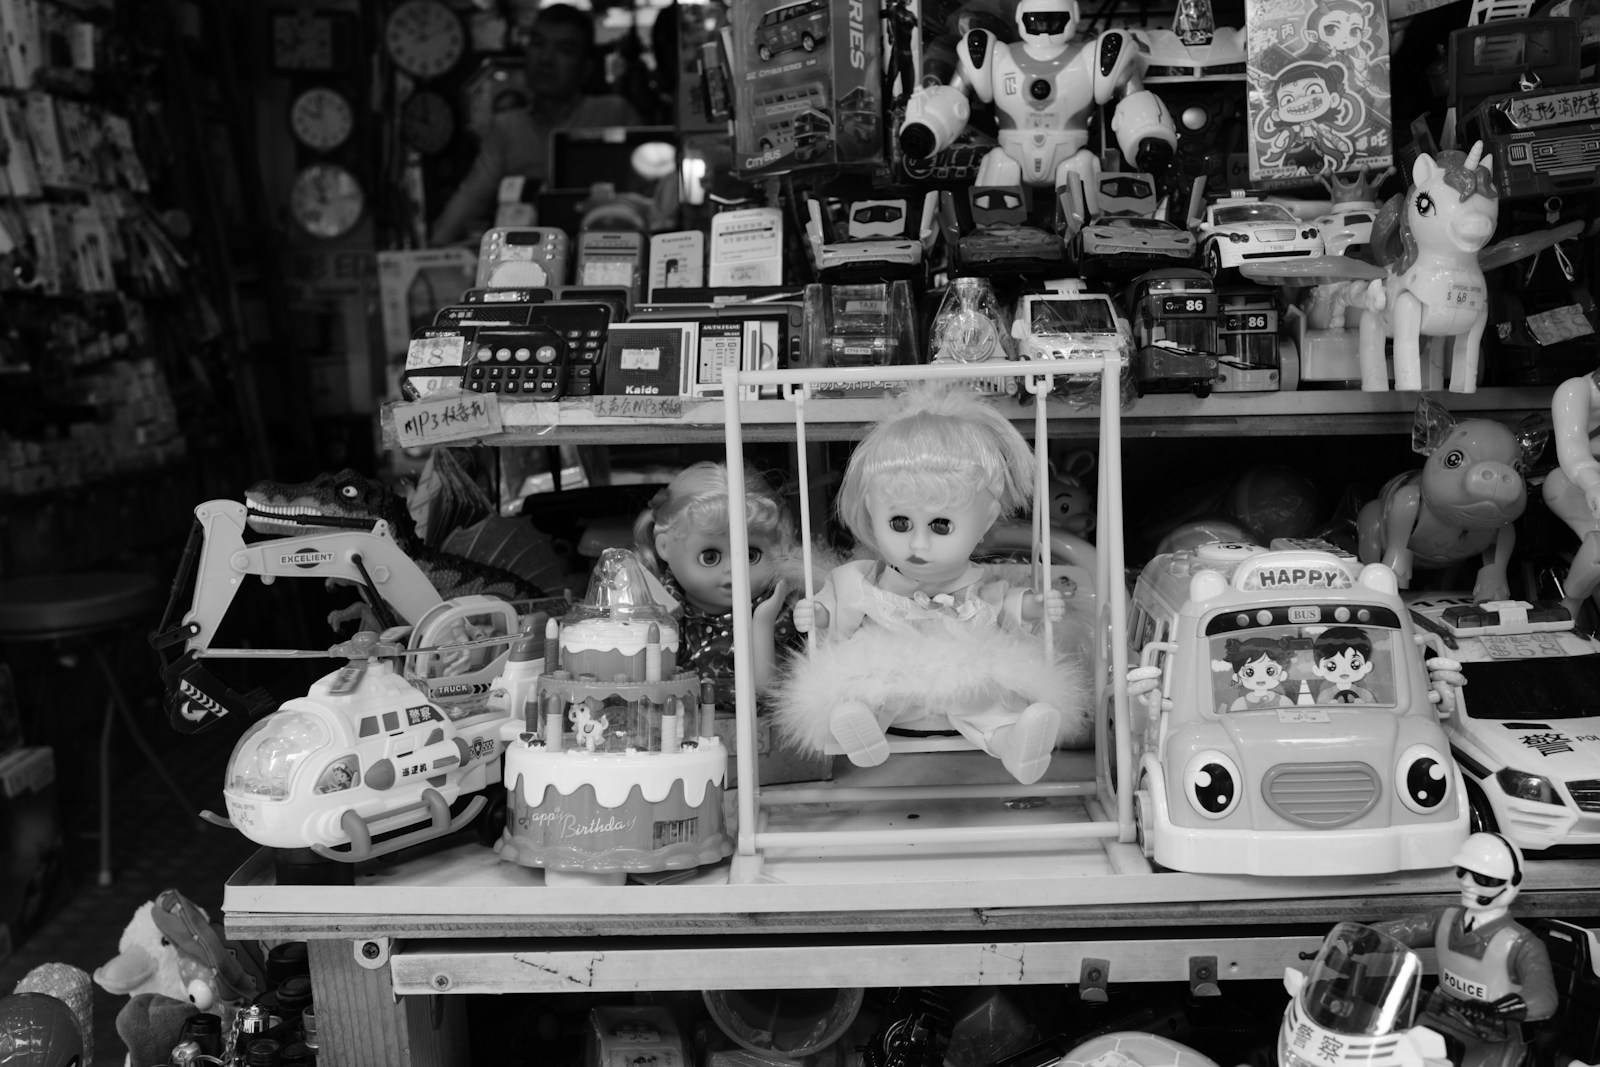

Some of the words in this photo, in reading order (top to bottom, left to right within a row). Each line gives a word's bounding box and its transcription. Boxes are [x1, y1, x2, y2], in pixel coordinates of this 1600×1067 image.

[1186, 300, 1203, 311] 86
[1248, 316, 1265, 328] 86
[626, 385, 659, 394] Kaide
[281, 553, 333, 563] EXCELIENT
[1259, 569, 1338, 587] HAPPY
[1294, 610, 1316, 620] BUS
[438, 684, 468, 694] TRUCK
[408, 706, 432, 724] 警察
[1518, 733, 1574, 757] 警
[560, 814, 638, 839] Birthday
[1444, 972, 1484, 998] POLICE
[1293, 1023, 1344, 1064] 警察
